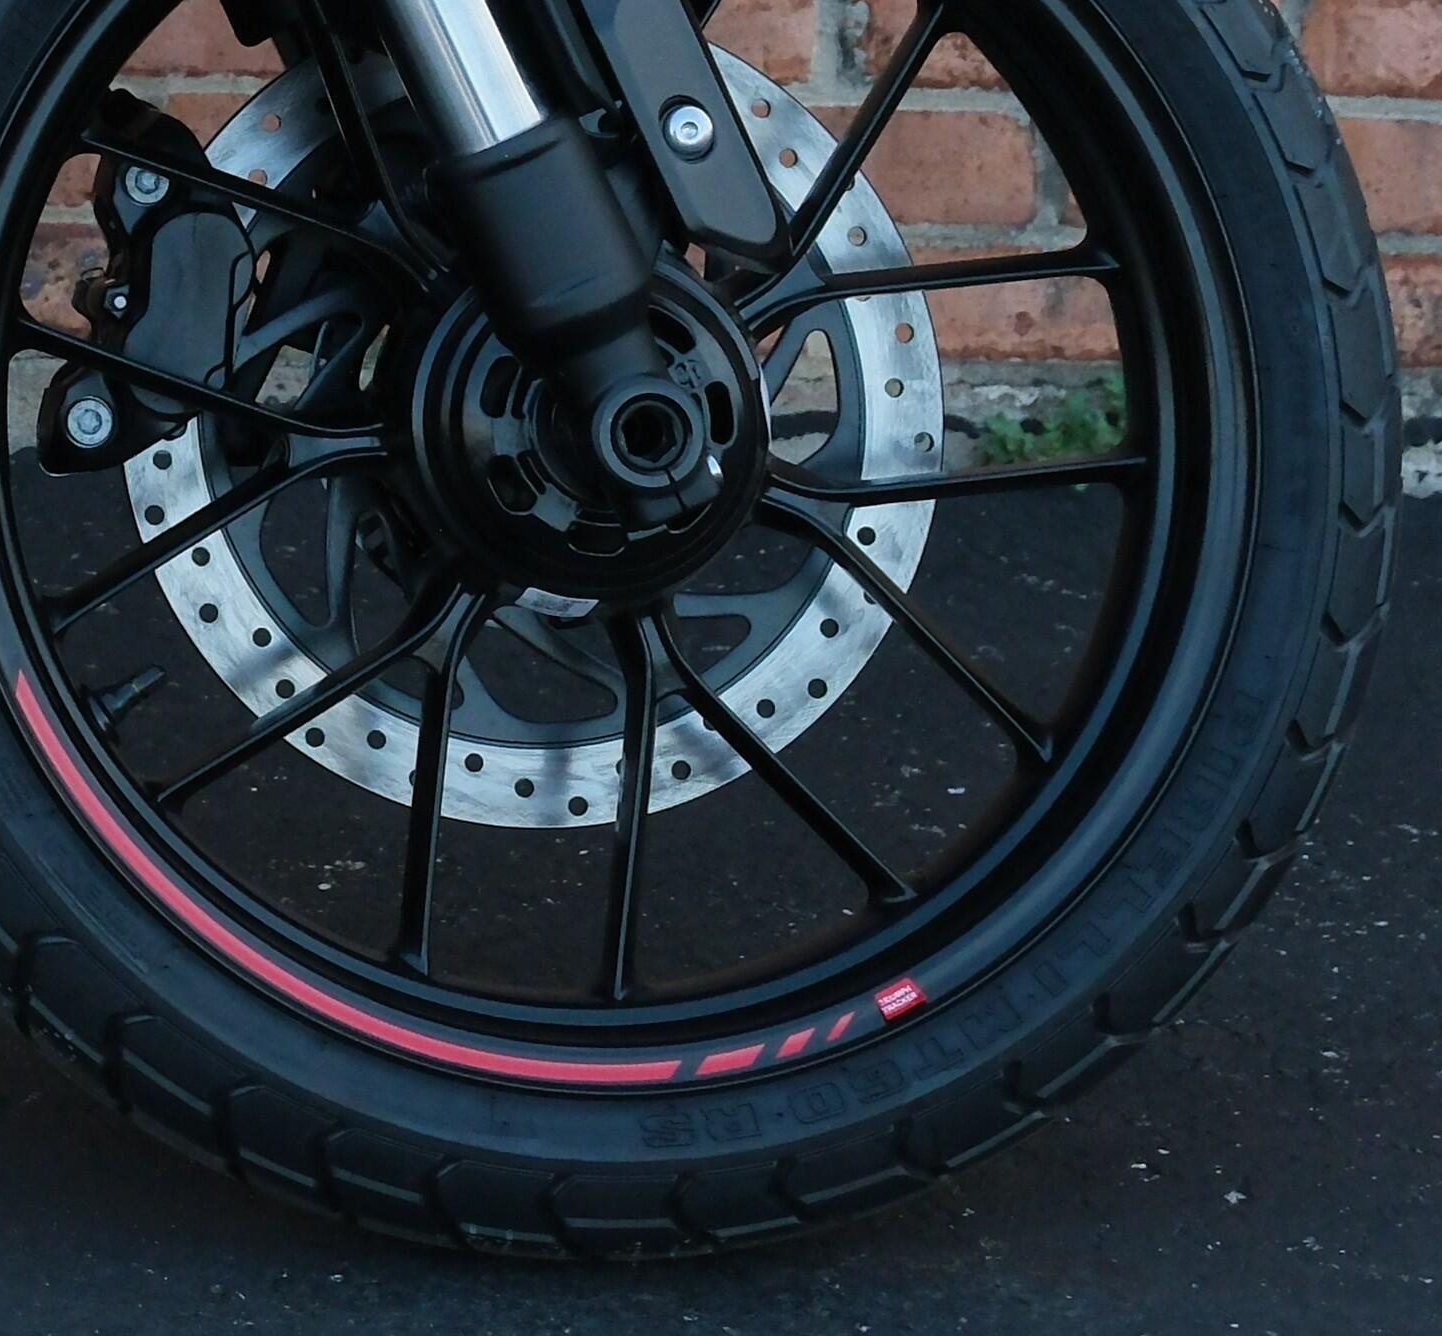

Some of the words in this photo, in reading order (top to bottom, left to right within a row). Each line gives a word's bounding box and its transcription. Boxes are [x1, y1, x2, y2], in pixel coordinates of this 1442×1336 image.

[1031, 689, 1265, 998] PIRELLI
[880, 992, 919, 1014] TRACKER
[789, 992, 1024, 1122] MT60
[639, 1103, 762, 1149] RS
